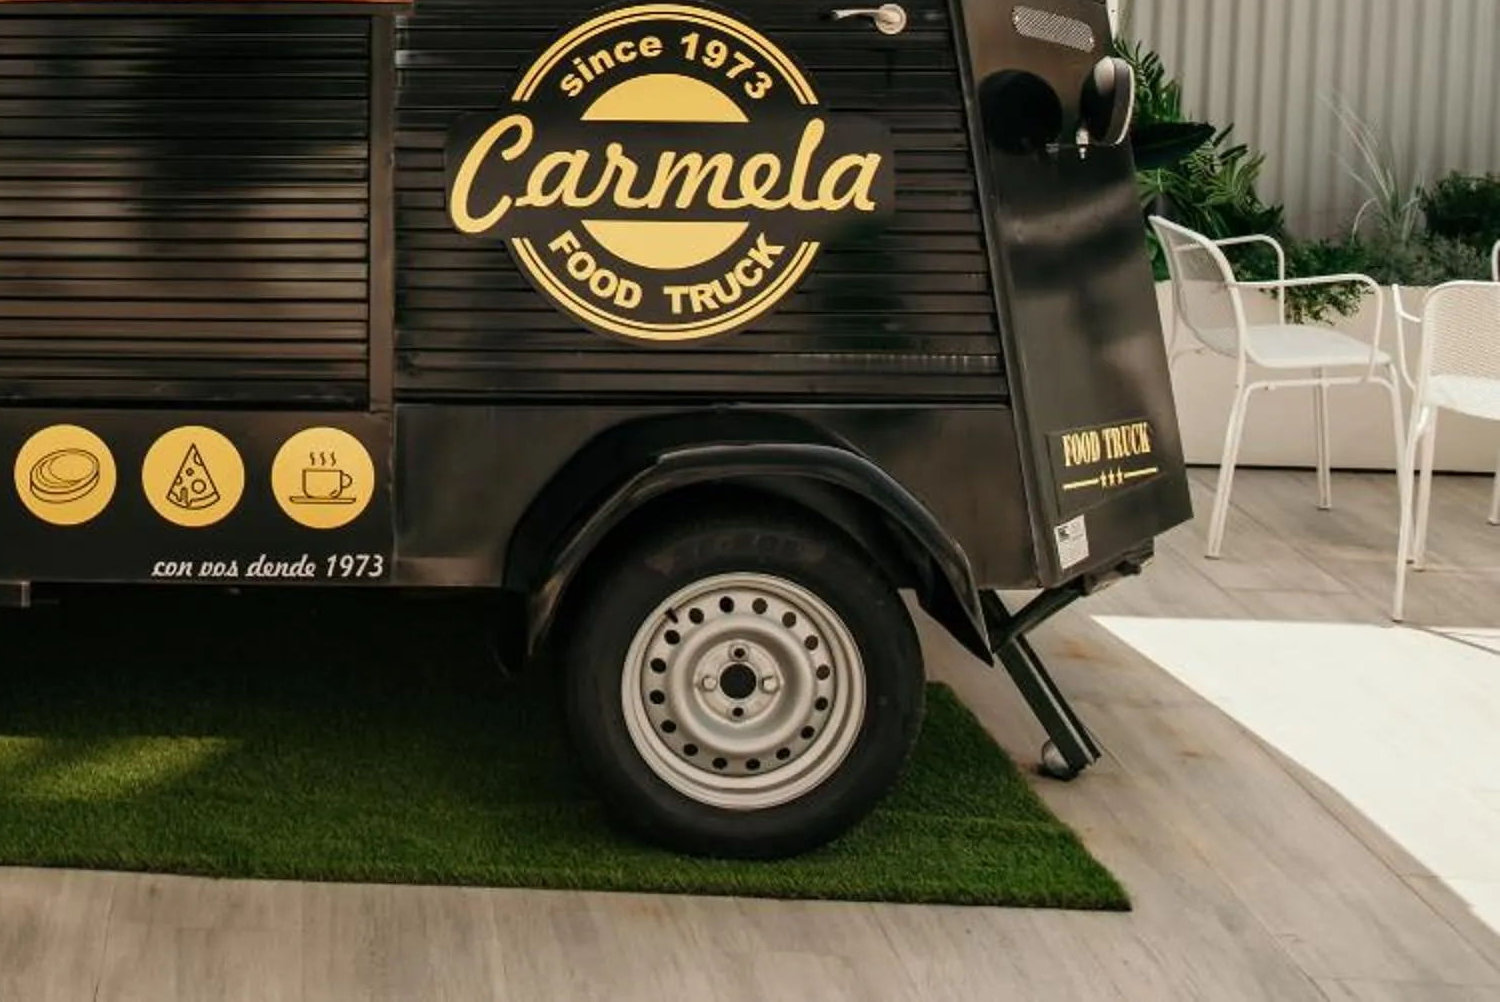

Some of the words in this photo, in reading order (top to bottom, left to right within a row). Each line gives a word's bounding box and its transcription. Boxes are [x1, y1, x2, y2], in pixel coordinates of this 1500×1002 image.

[560, 36, 663, 97] since
[681, 32, 773, 99] 1973
[450, 114, 883, 234] Carmela
[547, 229, 643, 309] FOOD
[663, 231, 786, 315] TRUCK
[1062, 430, 1101, 468] FOOD
[1101, 421, 1151, 460] TRUCK
[151, 560, 193, 577] con
[198, 559, 239, 577] vos
[327, 553, 384, 578] 1973
